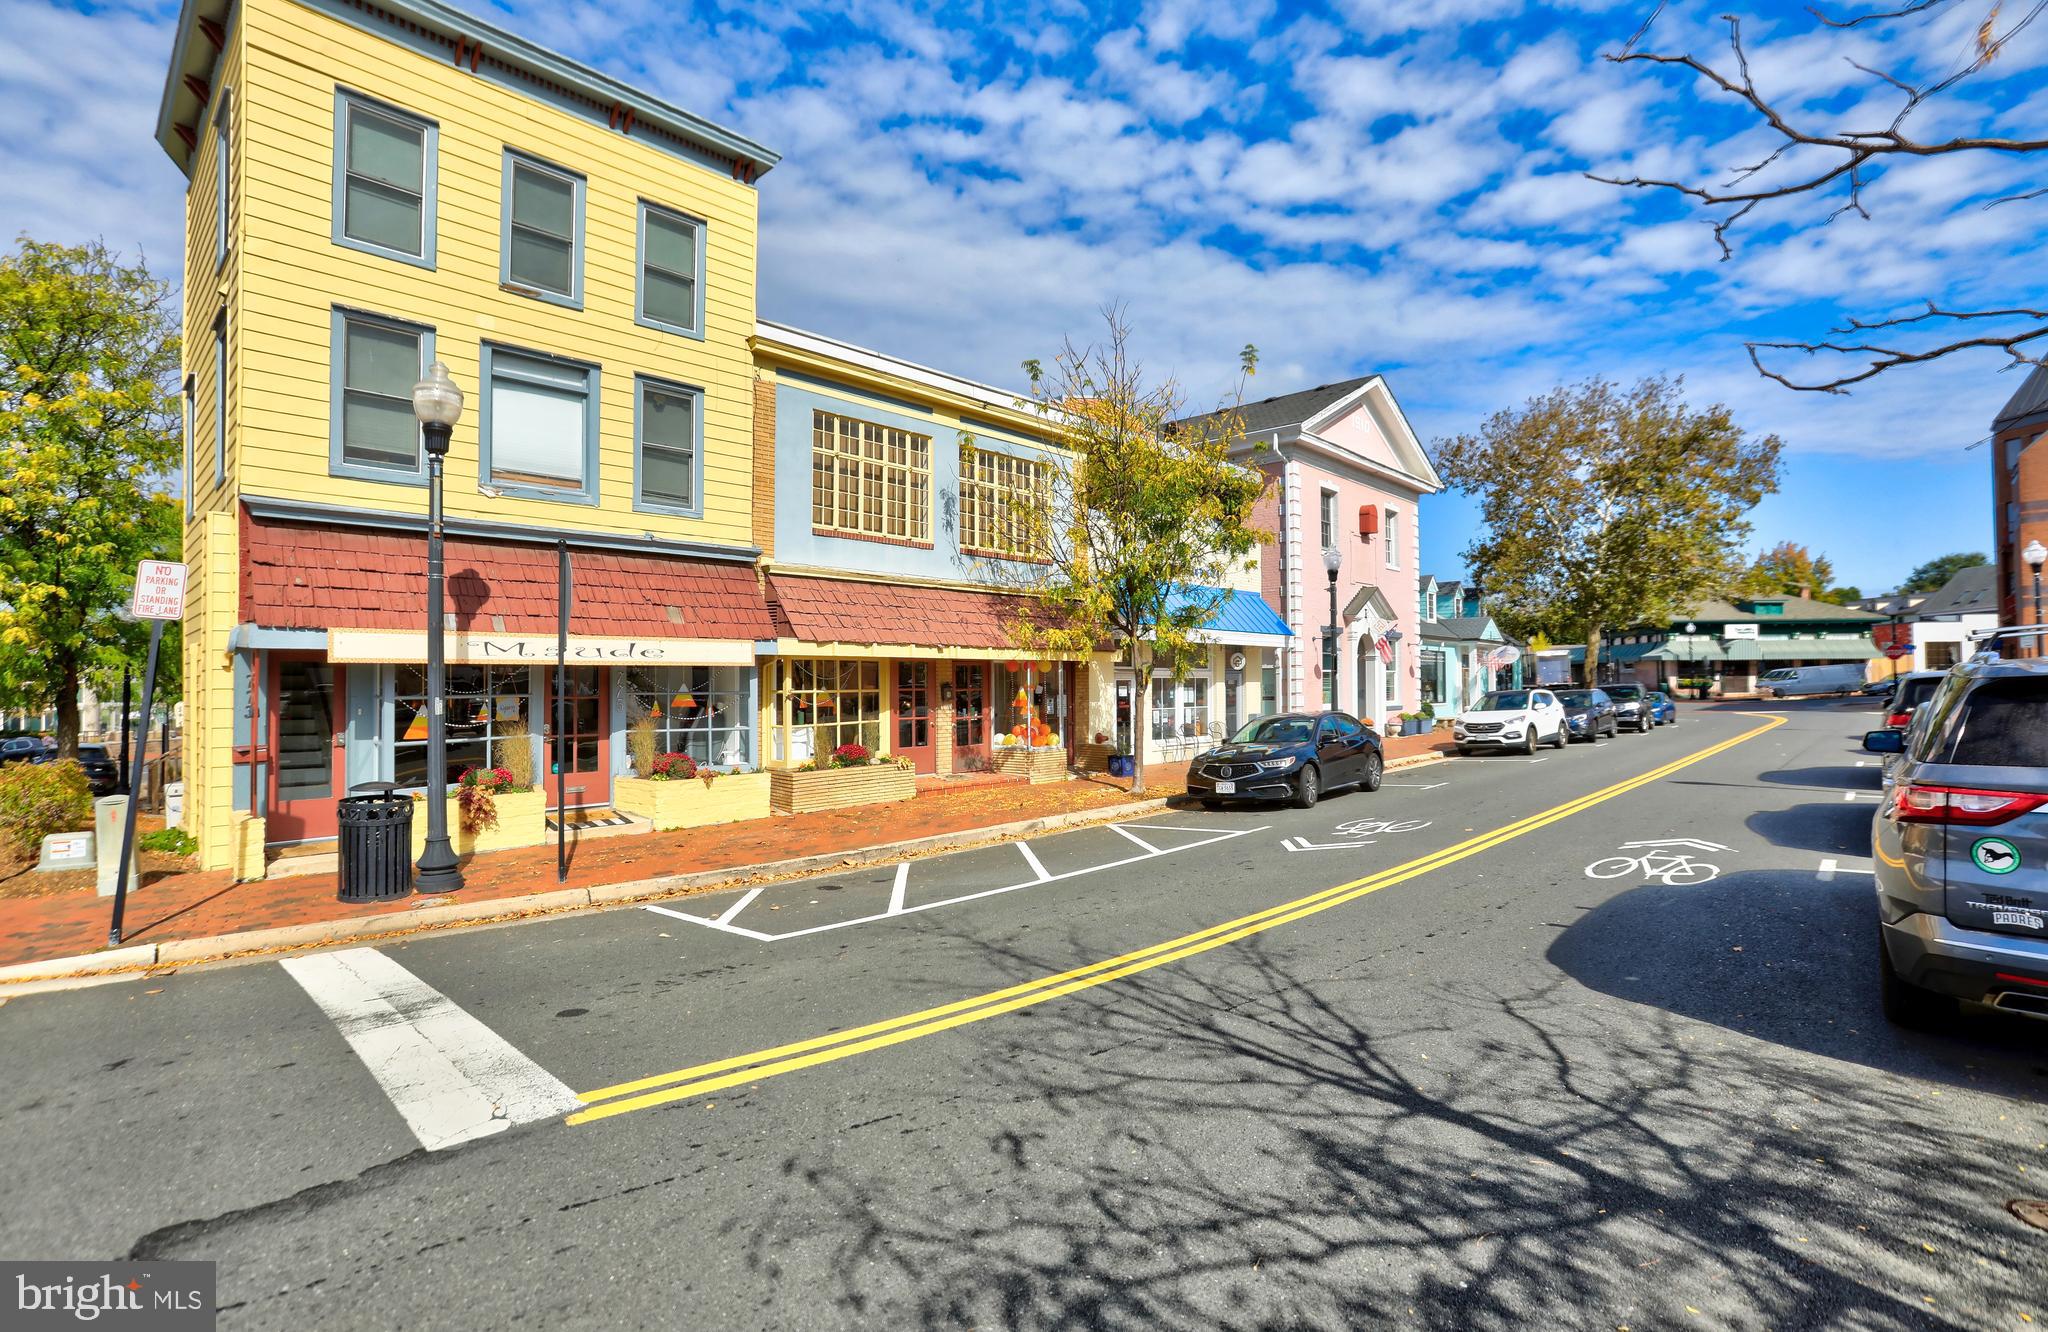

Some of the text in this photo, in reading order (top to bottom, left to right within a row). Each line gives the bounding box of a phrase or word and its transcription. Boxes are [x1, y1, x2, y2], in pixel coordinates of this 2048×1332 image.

[156, 565, 171, 576] NO
[145, 575, 179, 587] PARKING
[155, 586, 167, 595] OR
[140, 594, 179, 606] STANDING
[138, 603, 179, 616] FIRE LANE
[466, 641, 665, 659] Maude
[1994, 912, 2042, 929] PADRES
